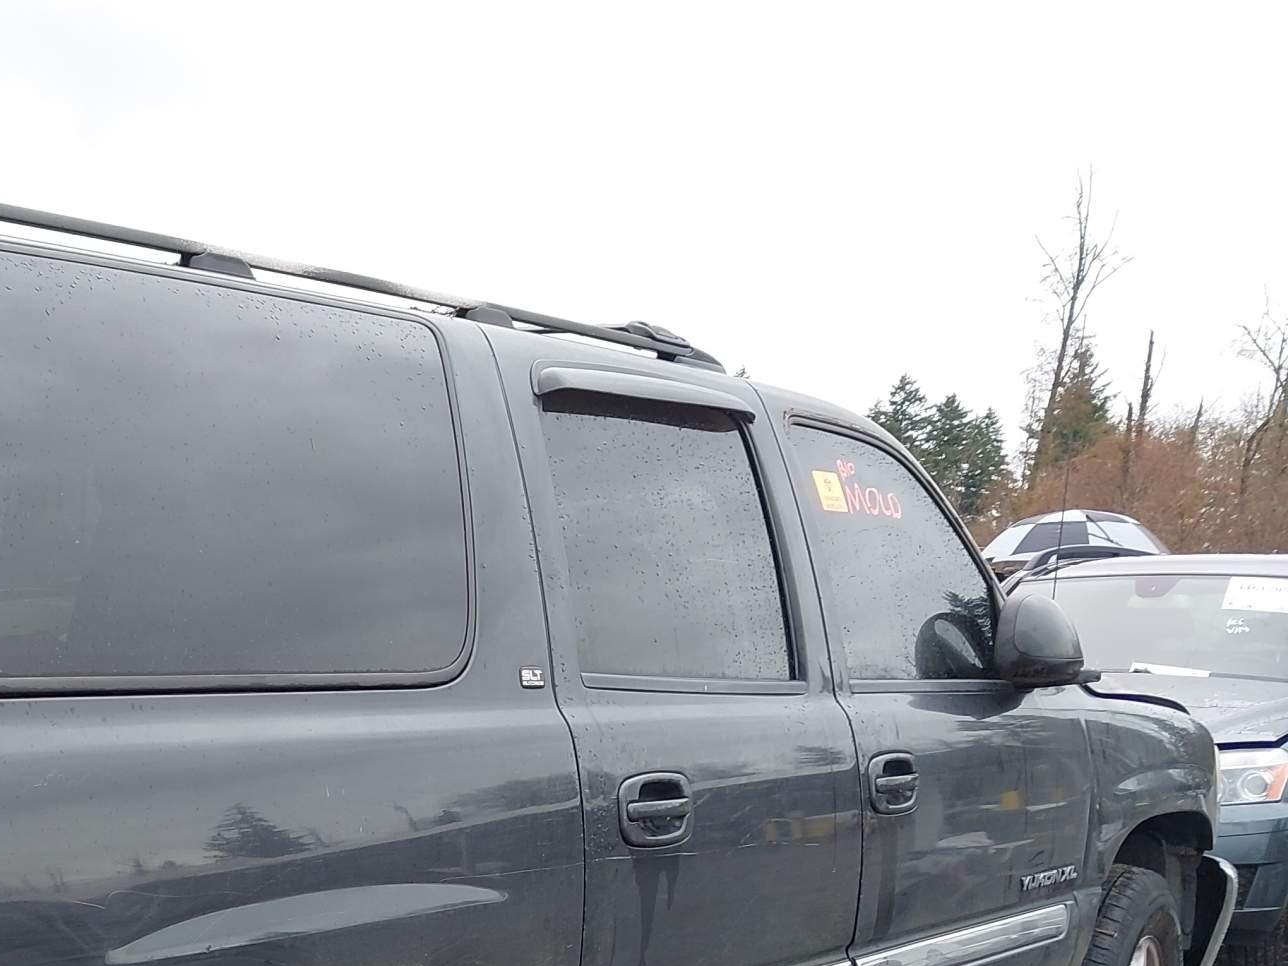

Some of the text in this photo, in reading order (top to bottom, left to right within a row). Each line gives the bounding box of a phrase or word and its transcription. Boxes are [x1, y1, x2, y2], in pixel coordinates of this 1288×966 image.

[844, 482, 902, 519] MOLD
[521, 669, 543, 681] SLT
[1020, 864, 1078, 891] YUKON XL
